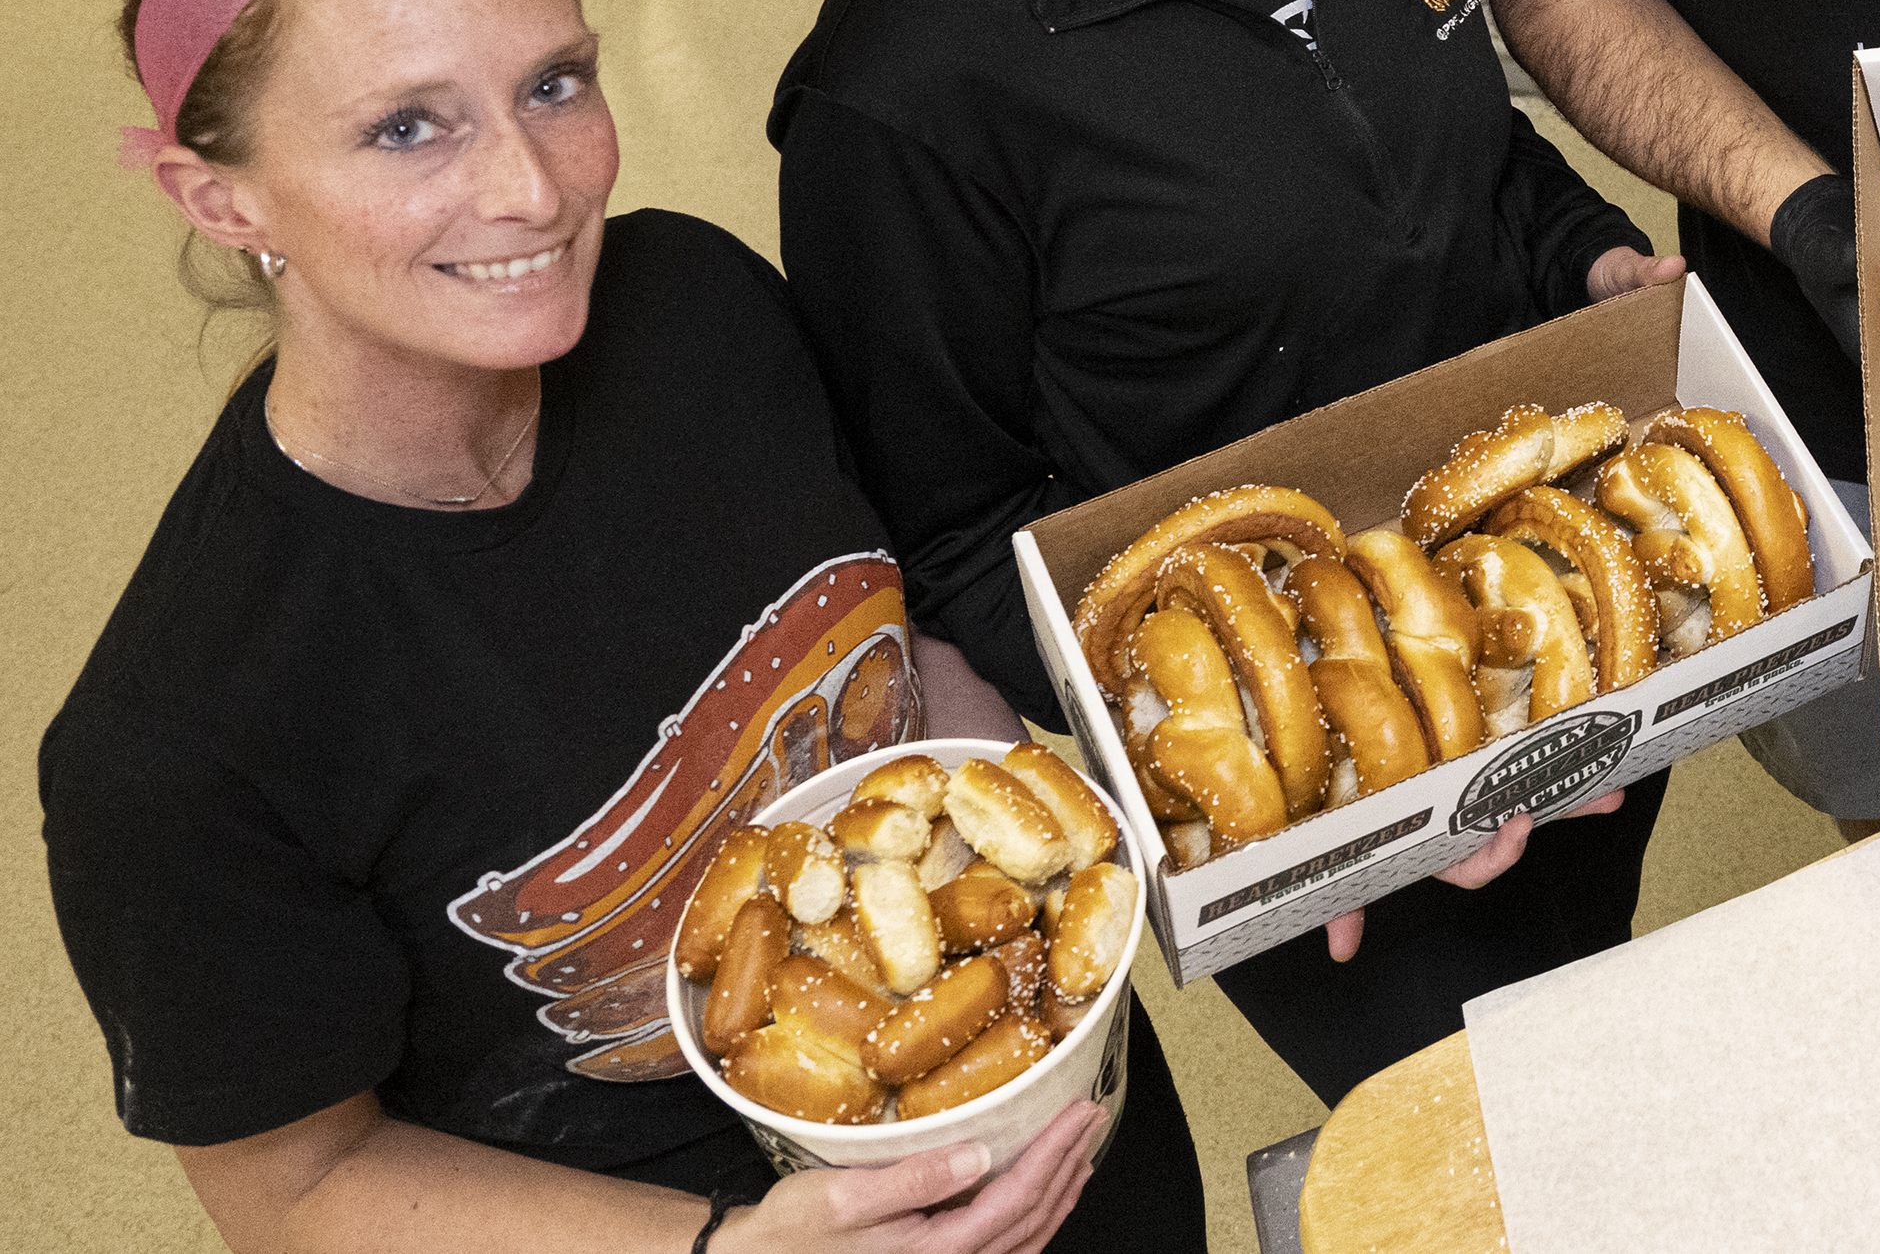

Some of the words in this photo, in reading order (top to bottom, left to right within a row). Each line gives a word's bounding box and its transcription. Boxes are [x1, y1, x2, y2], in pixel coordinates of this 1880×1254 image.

[1663, 681, 1723, 716] REAL
[1732, 622, 1850, 686] PRETZELS
[1704, 685, 1745, 708] travel
[1487, 735, 1611, 810] PRETZEL
[1490, 720, 1592, 786] PHILLY
[1496, 748, 1618, 828] FACTORY
[1207, 877, 1282, 919] REAL
[1292, 813, 1425, 884] PRETZELS
[1259, 881, 1307, 906] travel
